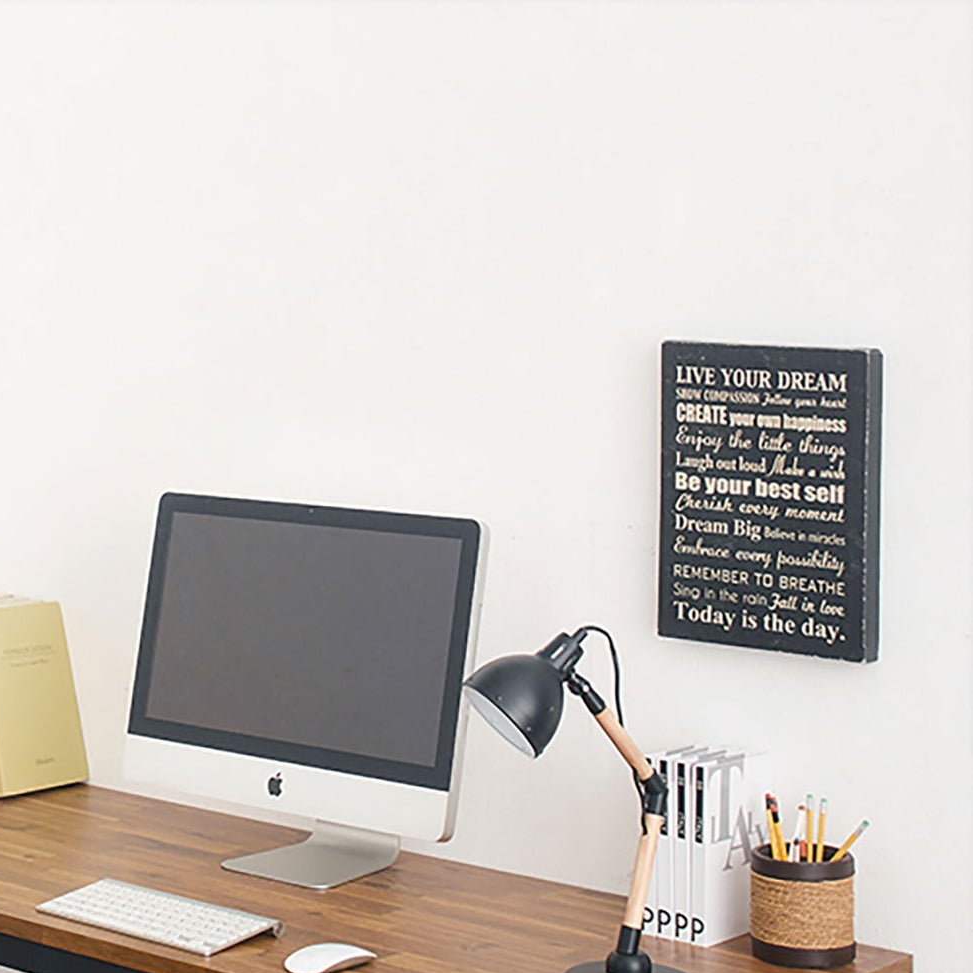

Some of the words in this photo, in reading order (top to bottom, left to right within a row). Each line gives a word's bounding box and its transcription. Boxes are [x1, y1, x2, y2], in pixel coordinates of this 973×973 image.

[676, 365, 716, 385] LIVE
[720, 368, 772, 389] YOUR
[777, 371, 847, 393] DREAM
[675, 388, 702, 400] SHOW
[703, 389, 761, 404] COMPASSION
[676, 402, 728, 425] CREATE
[729, 412, 756, 427] your
[756, 414, 781, 428] own
[782, 413, 847, 433] happiness
[675, 424, 724, 454] Enjoy
[728, 429, 753, 449] the
[758, 430, 793, 452] little
[799, 434, 846, 463] things
[676, 451, 714, 472] Laugh
[716, 457, 737, 471] out
[738, 456, 767, 473] loud
[766, 454, 804, 477] Make
[807, 467, 816, 477] a
[820, 460, 846, 480] wish
[675, 472, 701, 492] Be
[704, 477, 751, 495] your
[755, 478, 800, 500] best
[804, 484, 845, 504] self
[675, 494, 734, 512] Cherish
[739, 505, 779, 519] every
[785, 506, 845, 523] moment
[674, 514, 728, 534] Dream
[733, 519, 762, 541] Big
[764, 526, 796, 541] Believe
[673, 536, 730, 558] Embrace
[735, 551, 772, 569] every
[777, 549, 845, 577] possibility
[673, 564, 749, 585] REMEMBER
[754, 572, 773, 588] TO
[779, 576, 845, 597] BREATHE
[673, 582, 700, 600] Sing
[704, 585, 716, 600] in
[719, 587, 738, 603] the
[742, 593, 767, 605] rain
[767, 593, 798, 610] Fall
[801, 598, 815, 613] in
[819, 599, 845, 617] love
[673, 601, 736, 630] Today
[741, 609, 757, 629] is
[763, 614, 796, 634] the
[801, 619, 846, 645] day.
[657, 909, 671, 934] P
[675, 912, 688, 938] P
[691, 917, 704, 942] P
